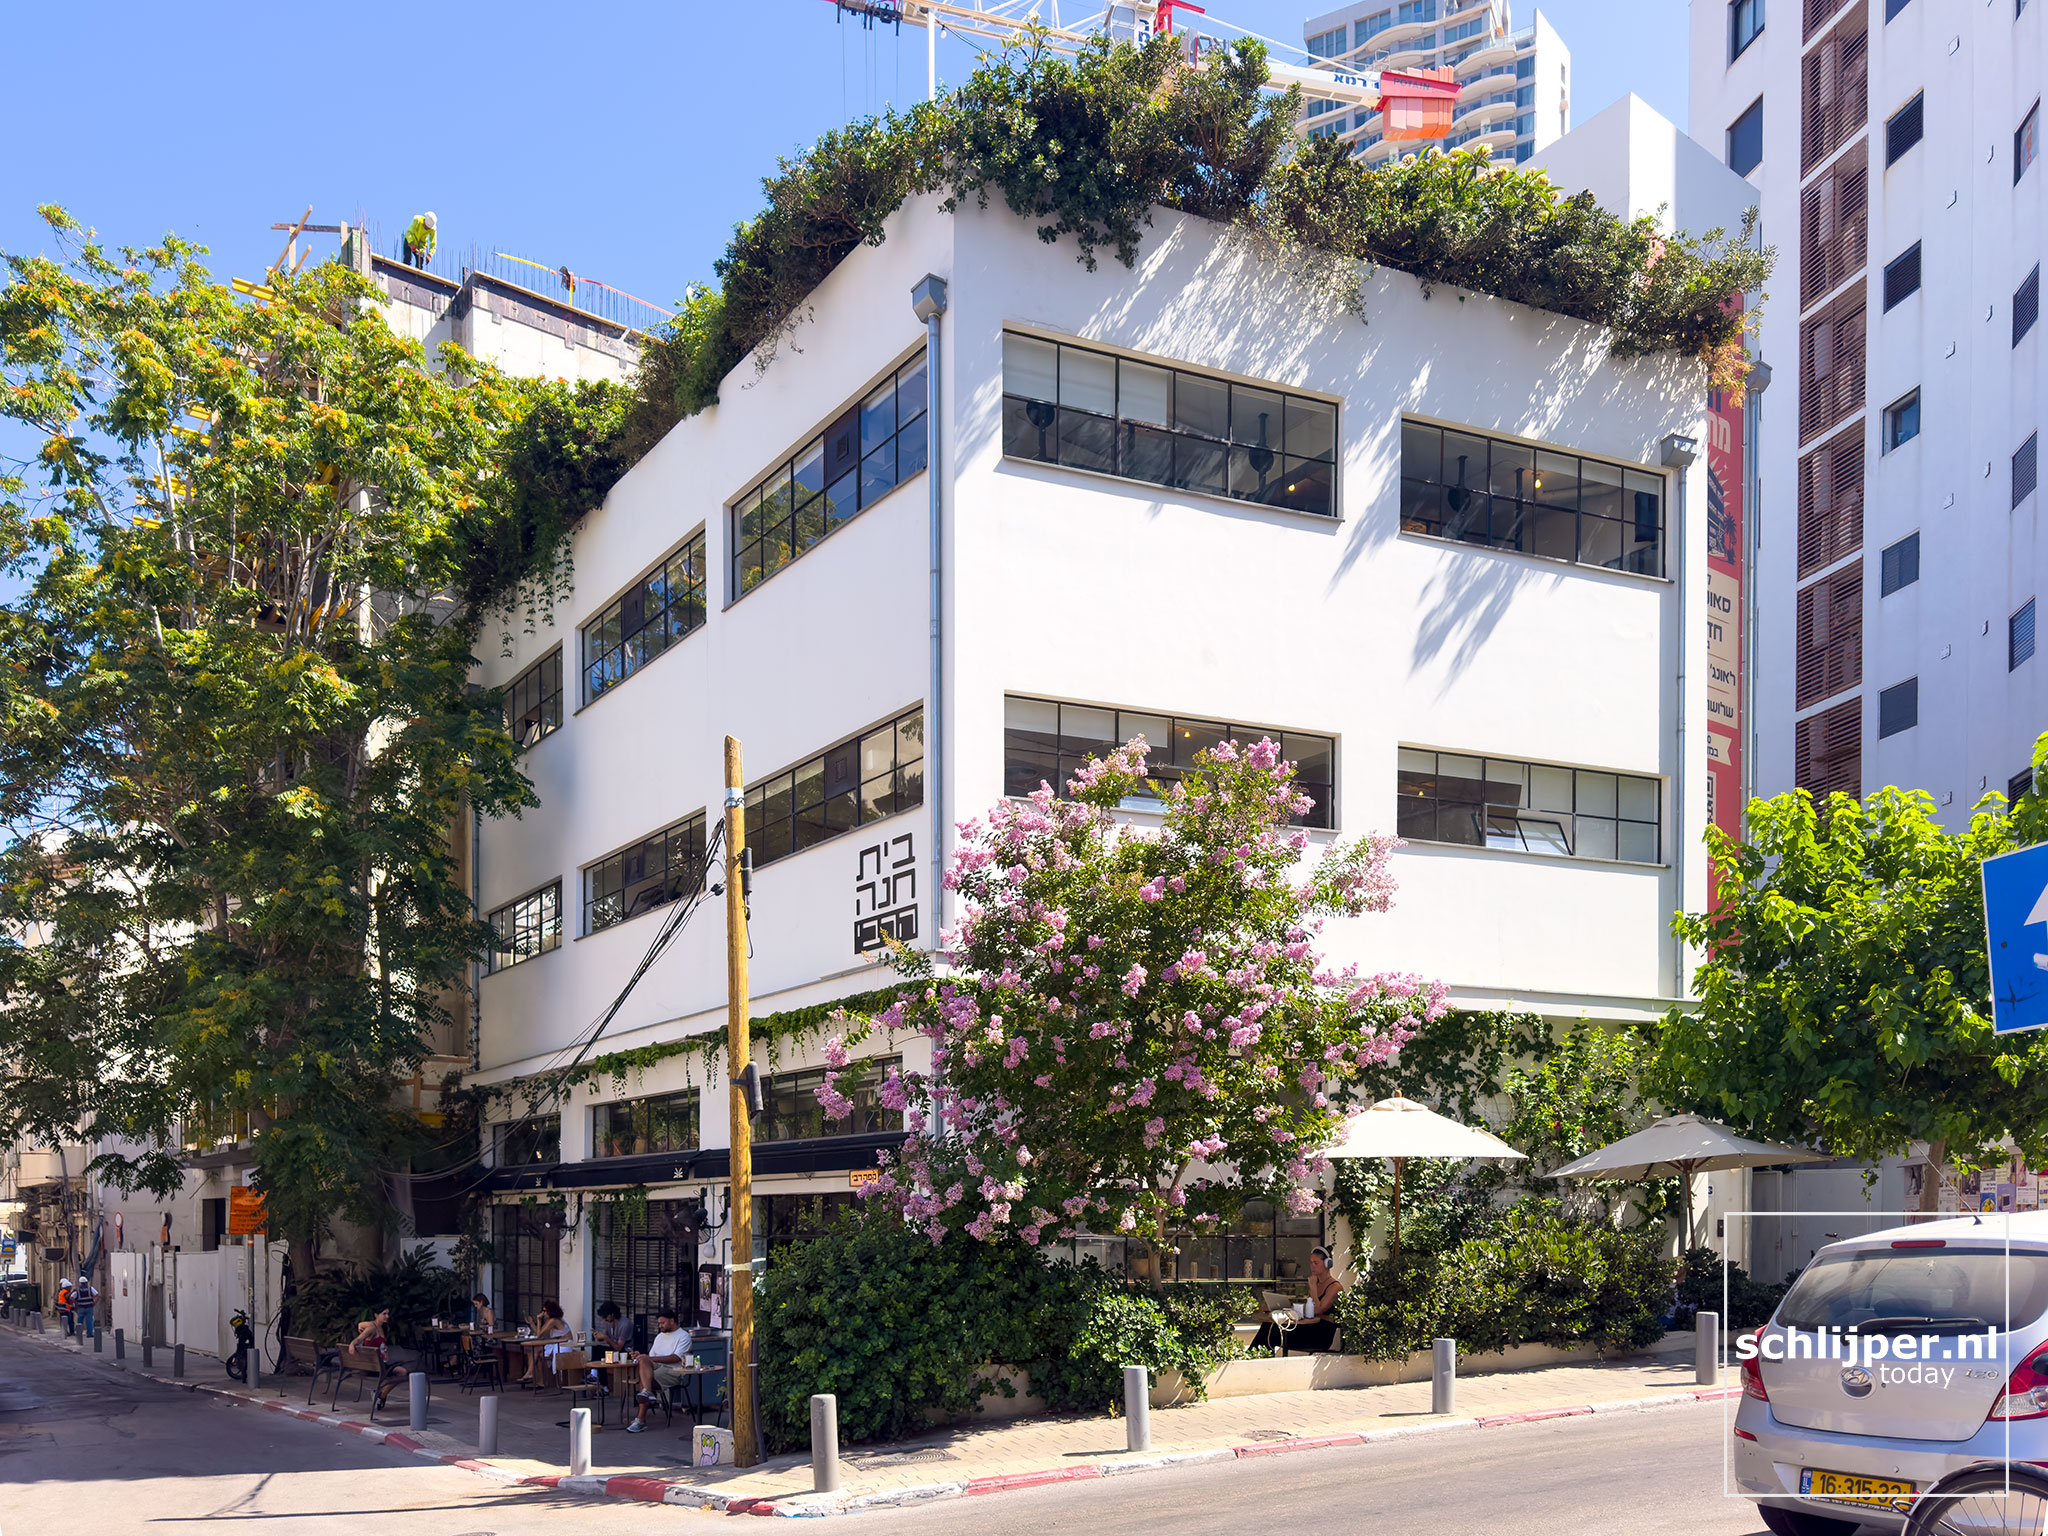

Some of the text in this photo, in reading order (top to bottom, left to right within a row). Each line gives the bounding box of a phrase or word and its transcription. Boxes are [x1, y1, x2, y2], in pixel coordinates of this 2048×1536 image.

[1394, 78, 1430, 91] POTAIN
[856, 832, 916, 881] בית
[856, 868, 916, 916] חנה
